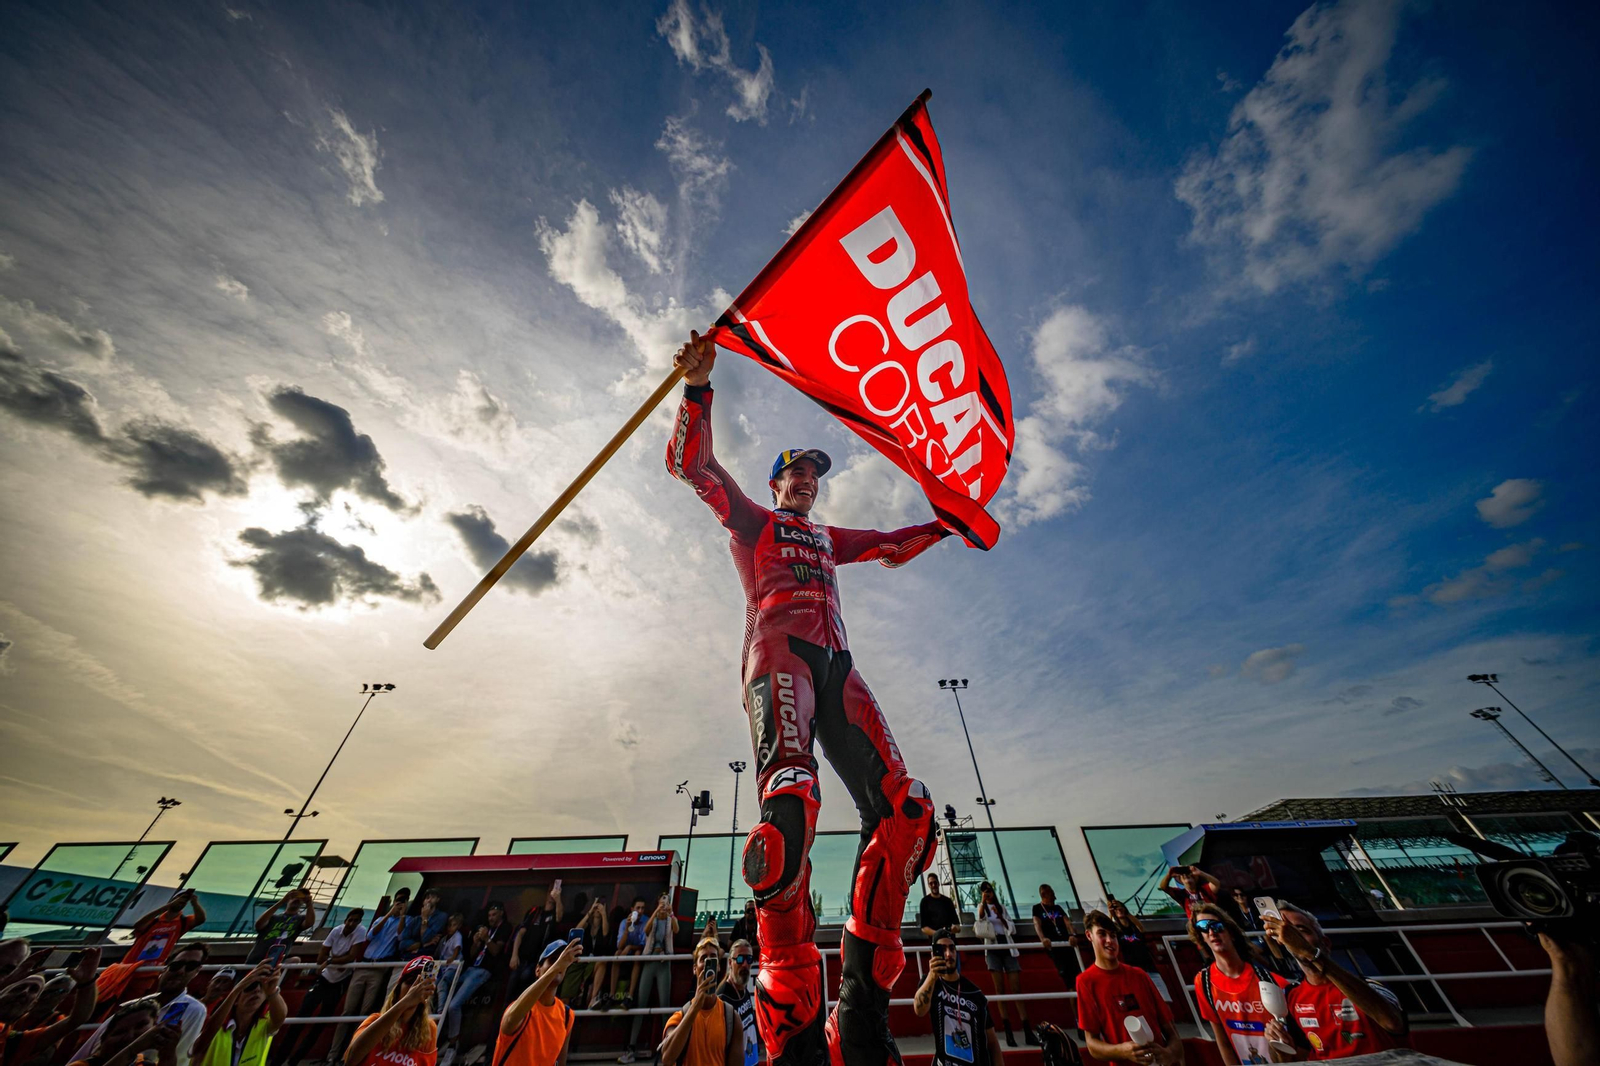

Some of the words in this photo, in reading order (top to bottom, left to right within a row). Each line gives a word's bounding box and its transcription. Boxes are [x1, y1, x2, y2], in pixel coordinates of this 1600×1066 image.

[776, 672, 803, 757] DUCATI
[29, 904, 76, 918] CREARE
[74, 907, 115, 920] FUTURO
[938, 990, 977, 1012] MotoGP
[1214, 999, 1265, 1014] MotoE
[1234, 1021, 1255, 1030] TRACK
[375, 1051, 417, 1066] Moto
